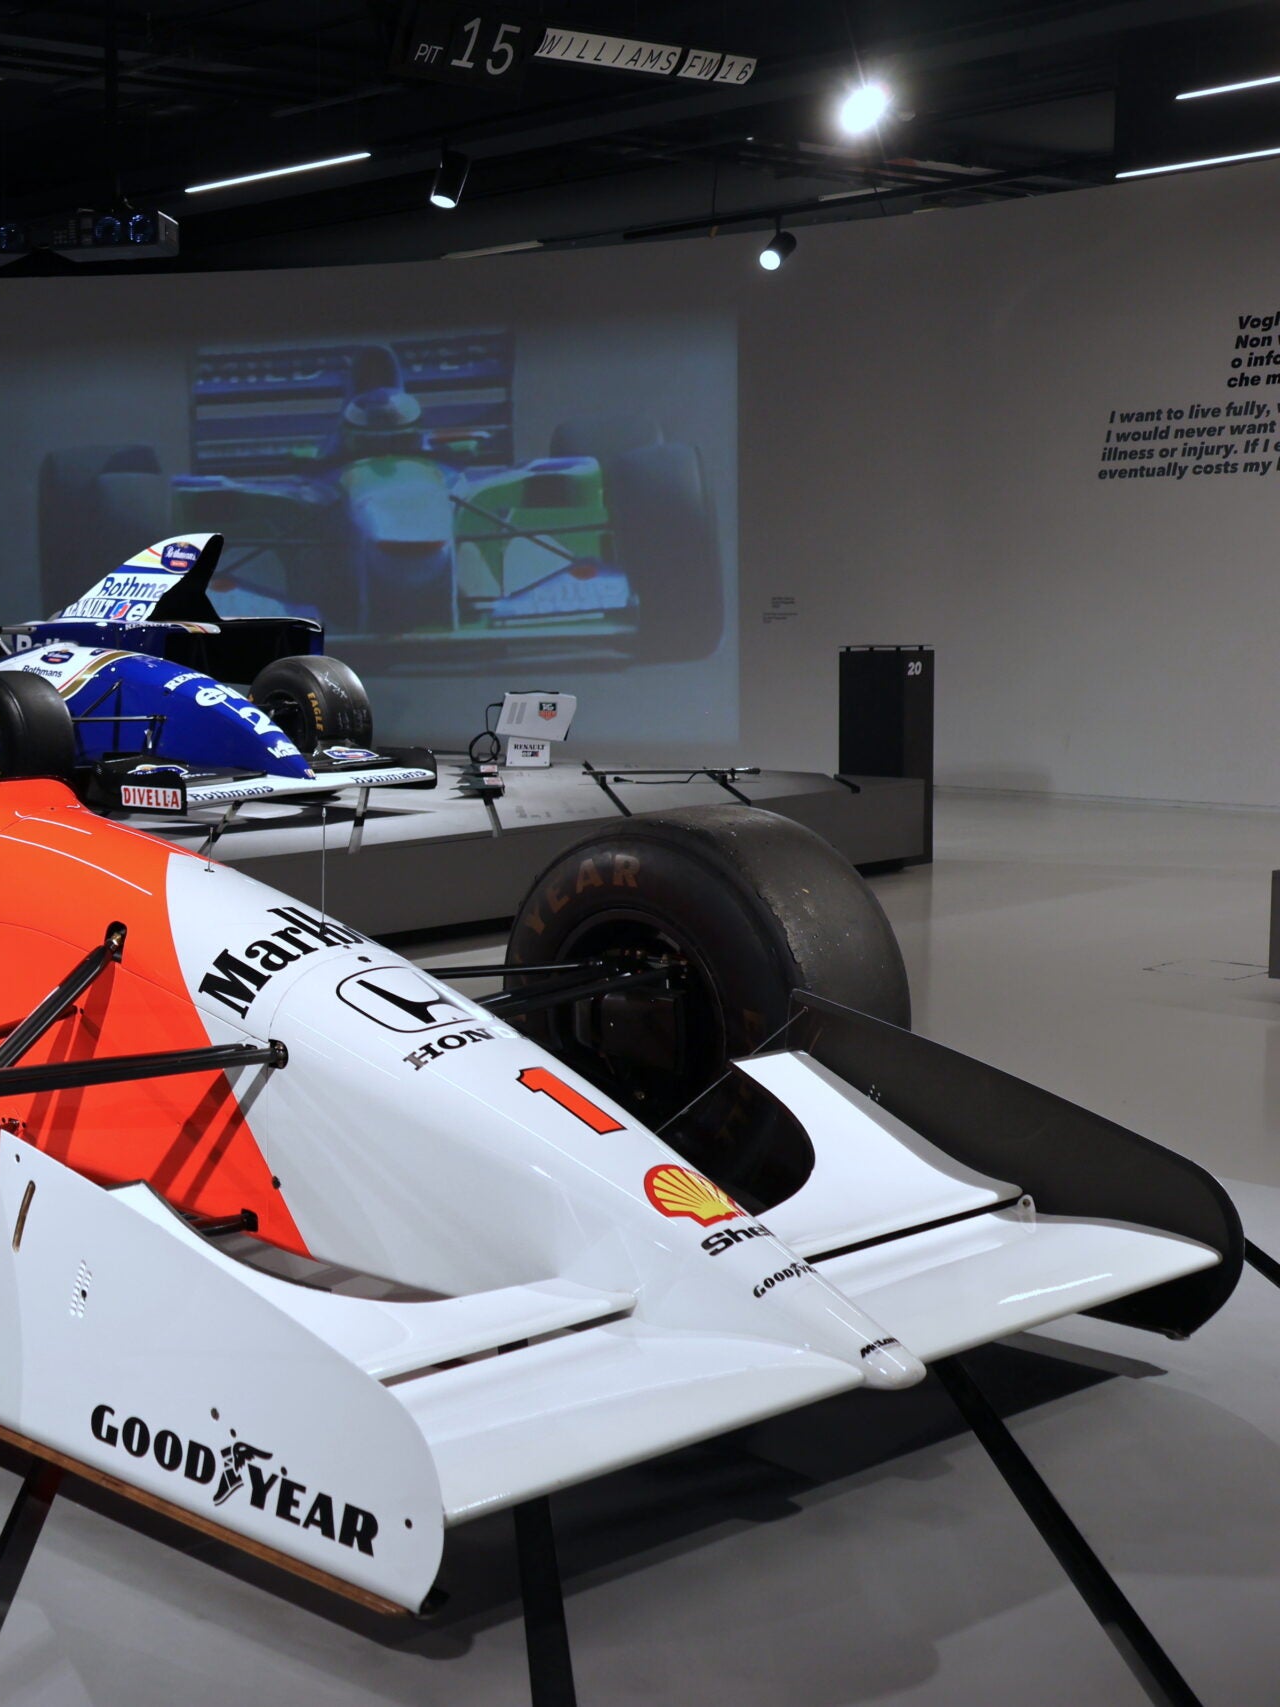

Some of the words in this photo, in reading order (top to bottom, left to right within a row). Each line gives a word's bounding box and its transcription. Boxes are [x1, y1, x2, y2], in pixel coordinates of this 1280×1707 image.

[414, 42, 444, 64] PIT
[450, 17, 521, 75] 15
[538, 32, 680, 72] WILLIAMS
[1235, 335, 1273, 349] Non
[1231, 357, 1242, 368] o
[1227, 372, 1261, 388] che
[1109, 410, 1116, 424] I
[1120, 408, 1163, 423] want
[1166, 407, 1185, 421] to
[1188, 404, 1222, 420] live
[1225, 400, 1271, 419] fully,
[1105, 430, 1112, 443] I
[1116, 425, 1171, 443] would
[1174, 425, 1226, 439] never
[1230, 420, 1277, 435] want
[1101, 447, 1155, 462] illness
[1159, 447, 1178, 458] or
[1181, 443, 1239, 461] injury.
[1244, 438, 1260, 454] If
[1263, 438, 1270, 453] I
[1098, 462, 1189, 480] eventually
[1192, 460, 1239, 475] costs
[1243, 461, 1273, 475] my
[21, 664, 64, 680] Rothmans
[907, 661, 923, 676] 20
[307, 691, 324, 732] EAGLE
[123, 787, 180, 809] DIVELLA
[516, 1066, 628, 1135] 1
